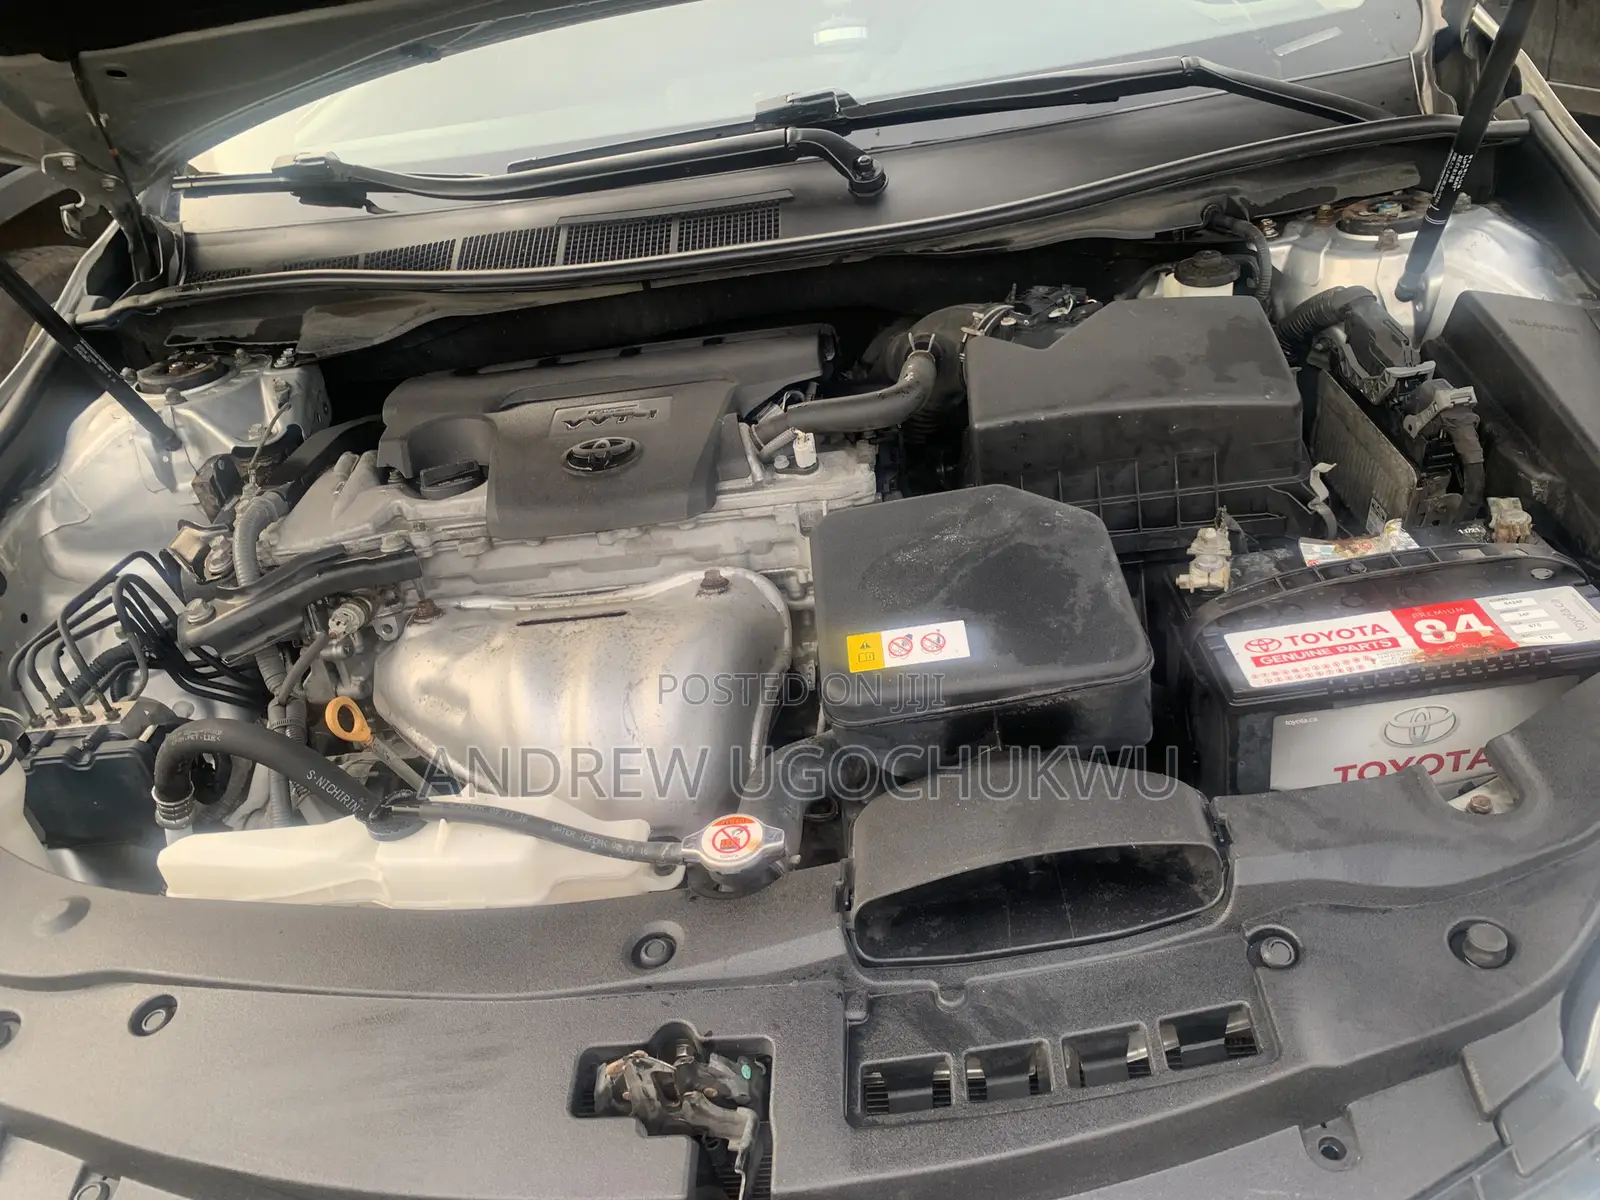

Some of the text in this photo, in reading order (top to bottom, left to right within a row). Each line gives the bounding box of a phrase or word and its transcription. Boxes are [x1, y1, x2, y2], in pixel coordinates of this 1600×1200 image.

[1411, 606, 1466, 620] PREMIUM
[1284, 623, 1389, 646] TOYOTA
[1414, 613, 1494, 644] 84
[1259, 639, 1392, 665] GENUINE PARTS
[1285, 716, 1319, 726] toyota.ca
